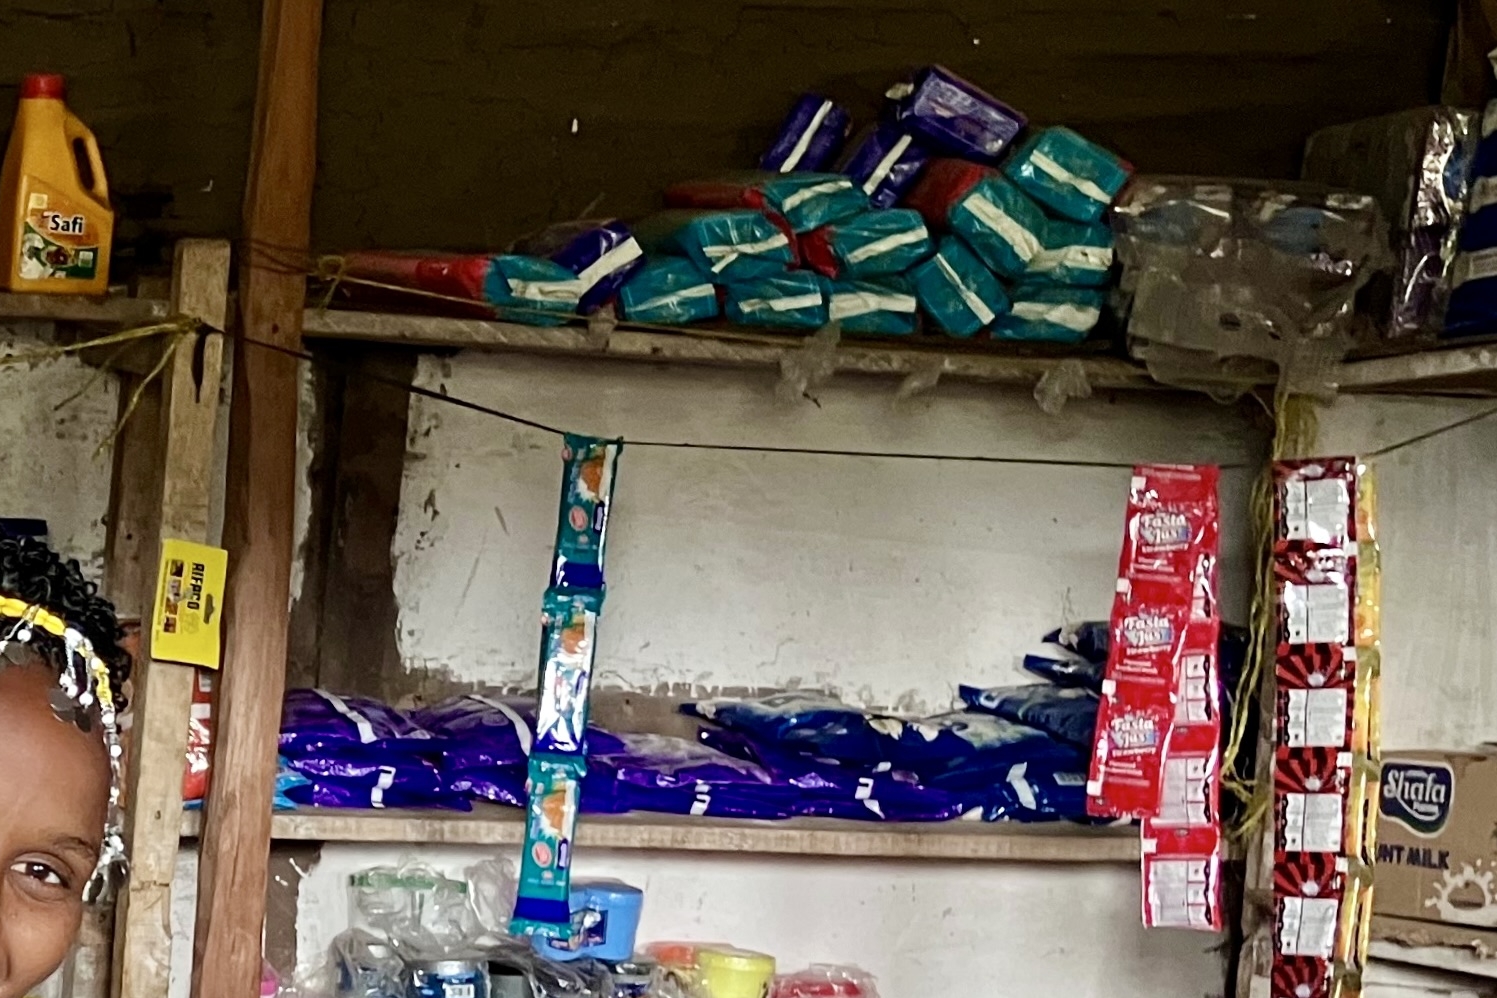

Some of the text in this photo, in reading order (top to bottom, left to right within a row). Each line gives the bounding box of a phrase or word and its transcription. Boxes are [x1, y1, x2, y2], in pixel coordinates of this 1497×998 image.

[50, 213, 84, 234] Safi
[1383, 769, 1446, 804] Shafa
[1407, 847, 1450, 869] MILK
